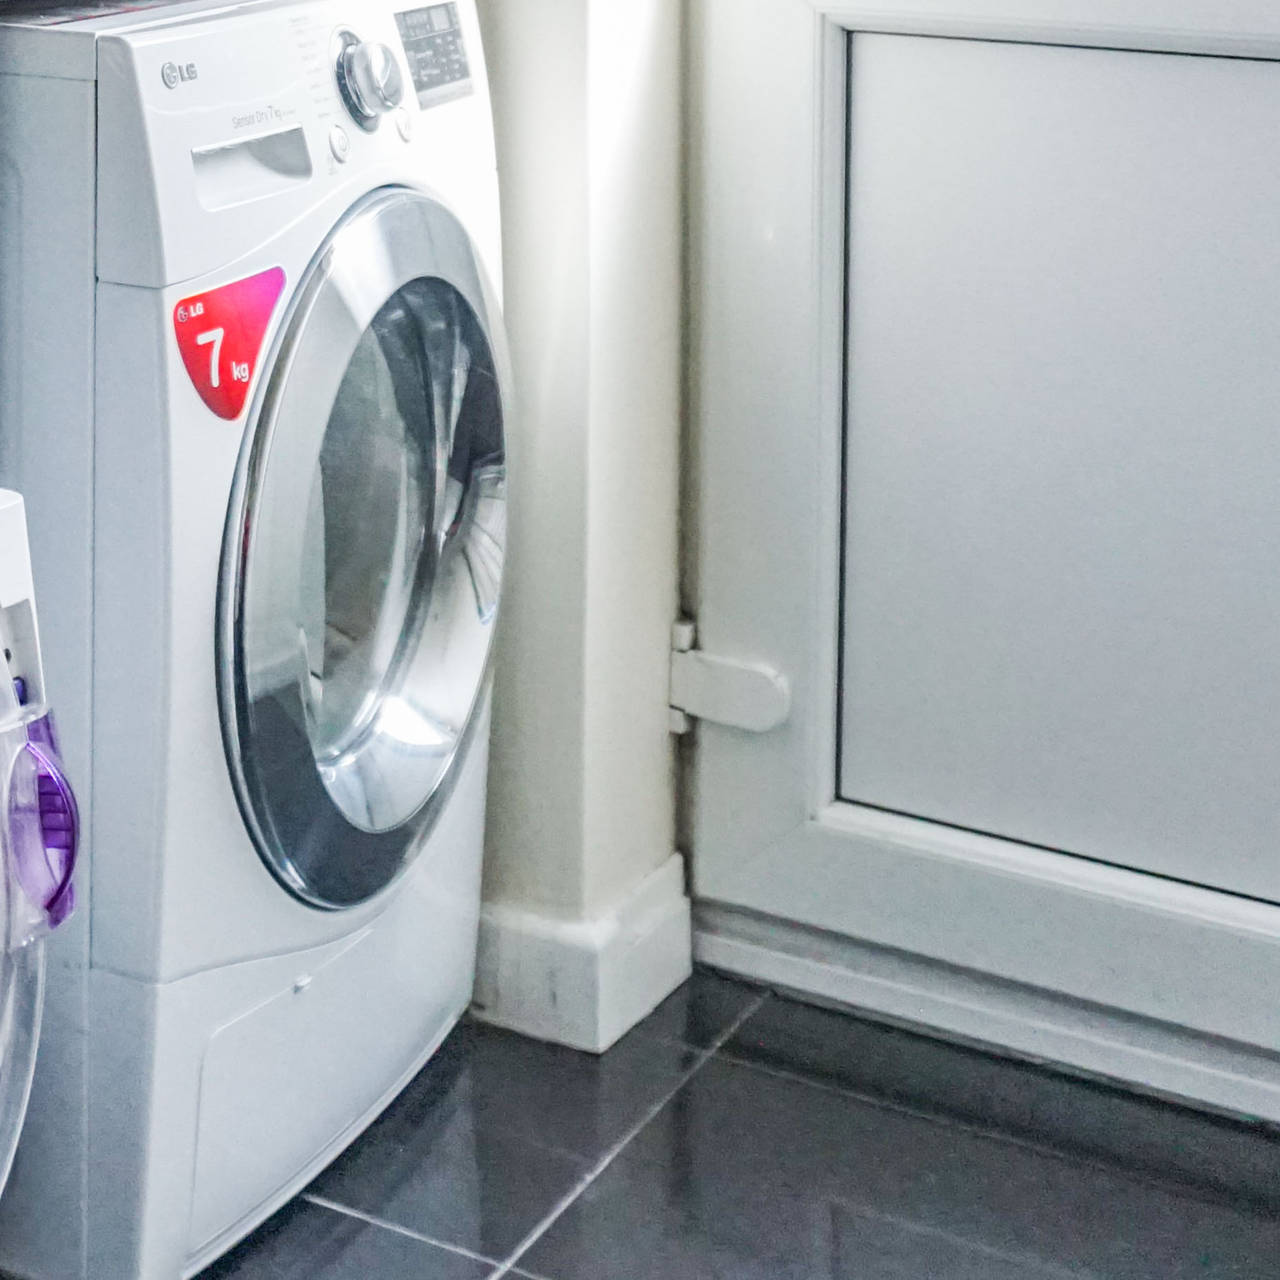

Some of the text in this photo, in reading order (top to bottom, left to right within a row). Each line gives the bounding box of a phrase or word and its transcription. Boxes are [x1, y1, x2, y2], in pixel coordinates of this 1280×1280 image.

[178, 62, 199, 83] LG
[189, 302, 204, 318] LG
[196, 326, 250, 388] 7 kg
